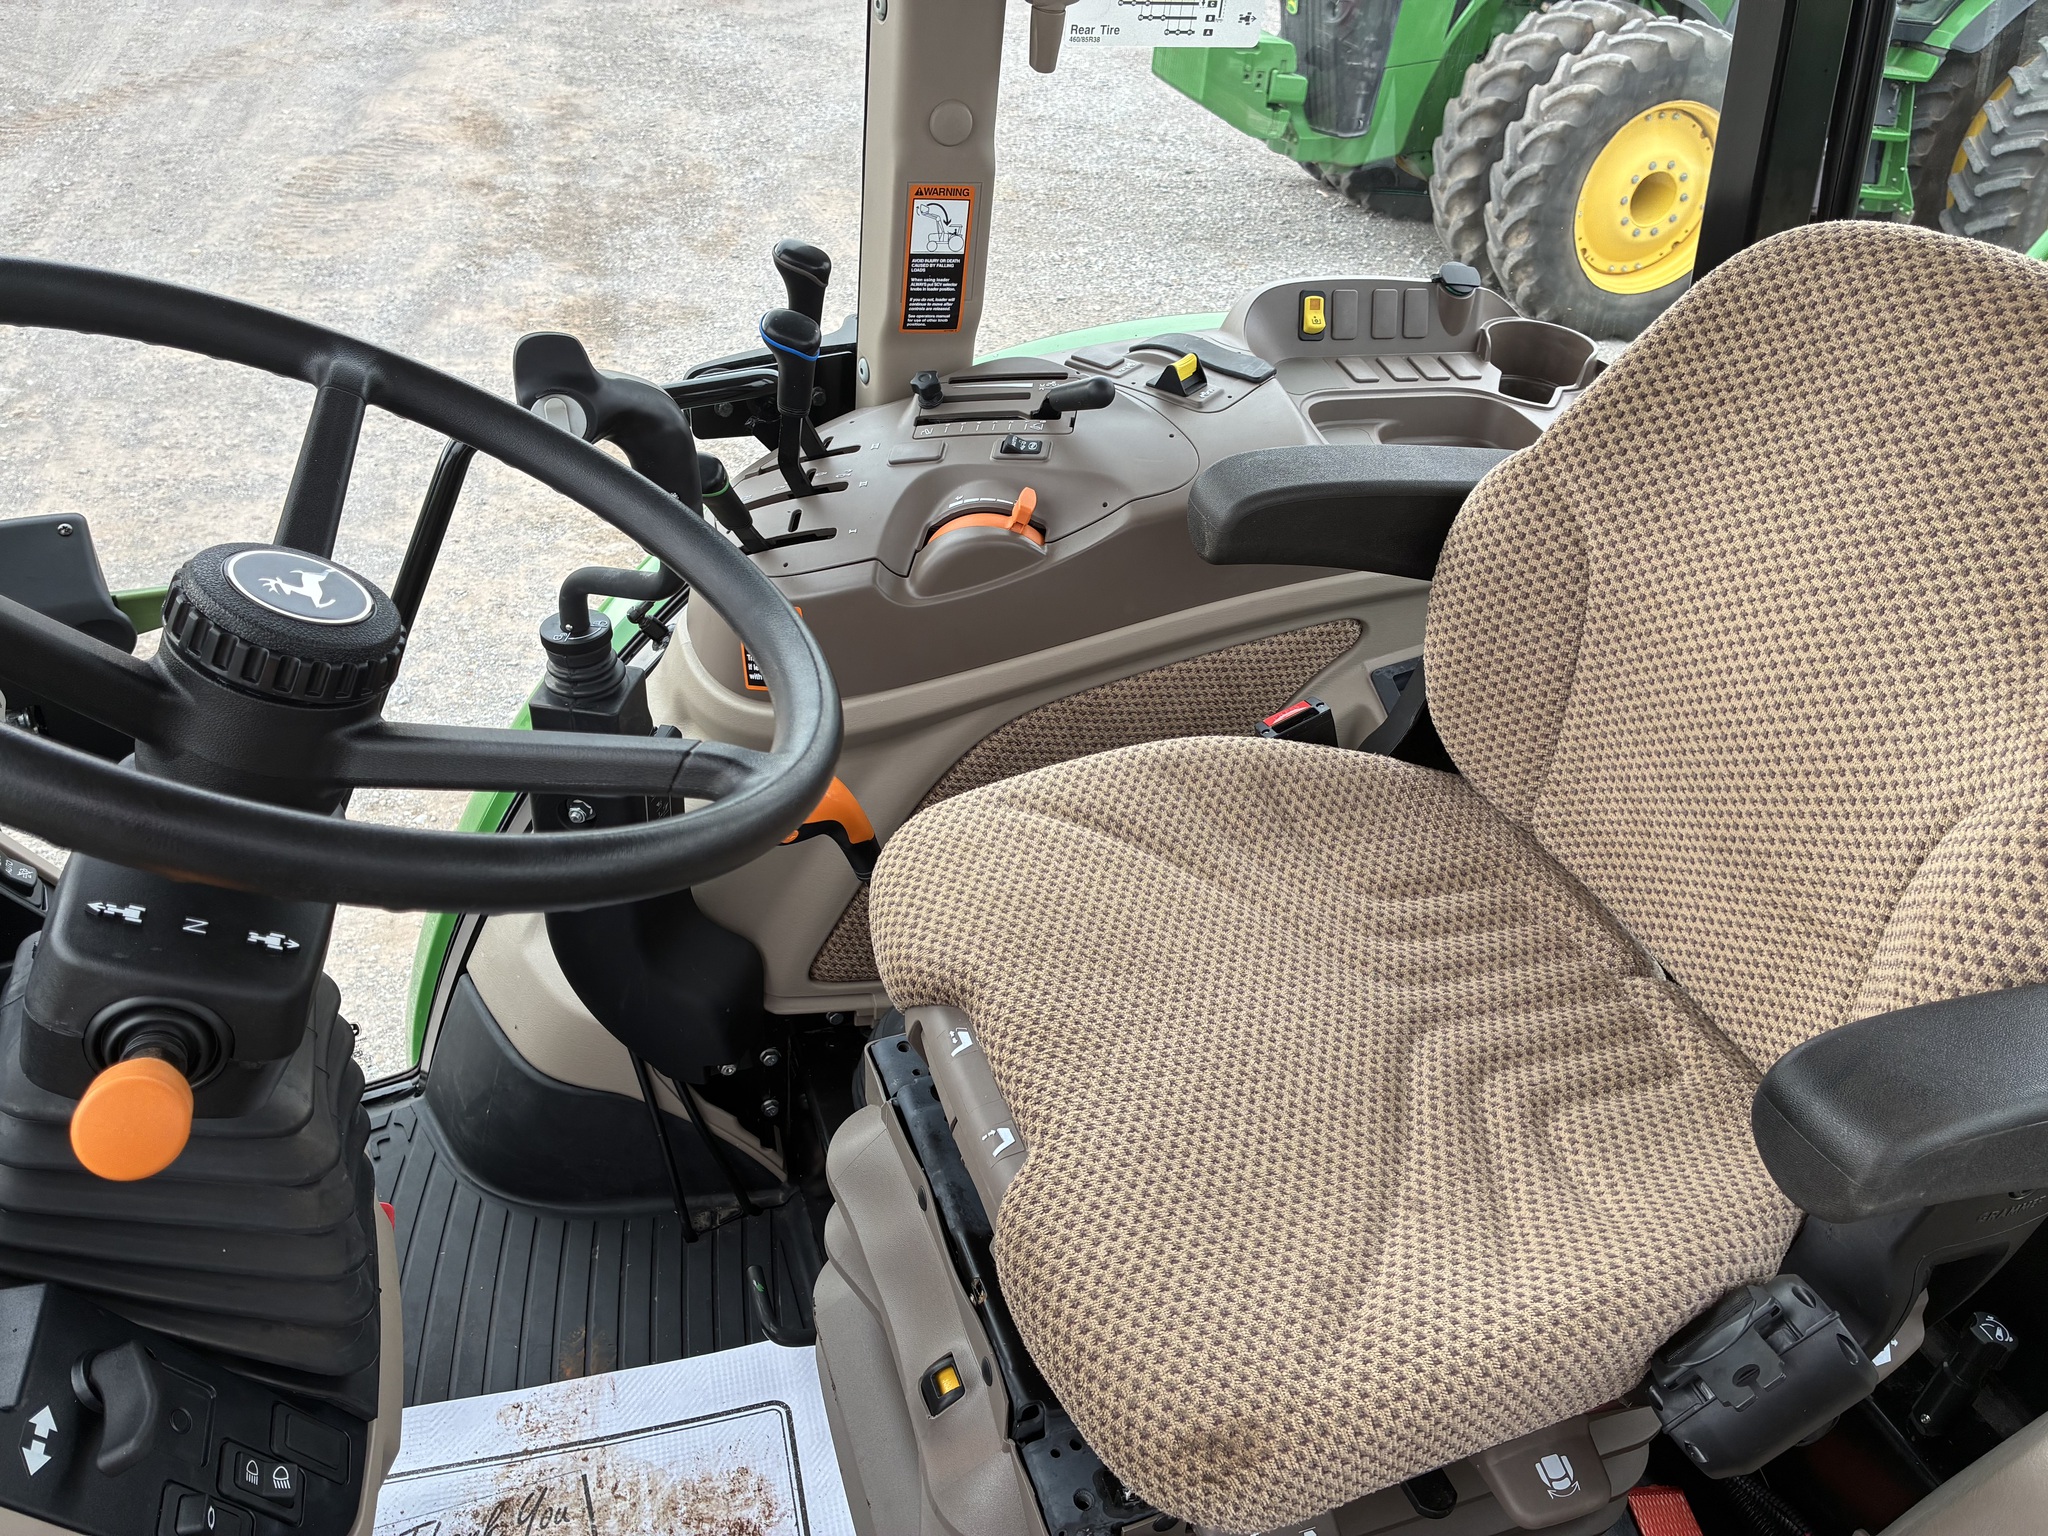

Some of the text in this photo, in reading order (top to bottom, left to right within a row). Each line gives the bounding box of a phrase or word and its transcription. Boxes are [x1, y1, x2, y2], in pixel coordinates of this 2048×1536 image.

[1070, 24, 1120, 35] Rear Tire
[924, 187, 970, 196] WARNING
